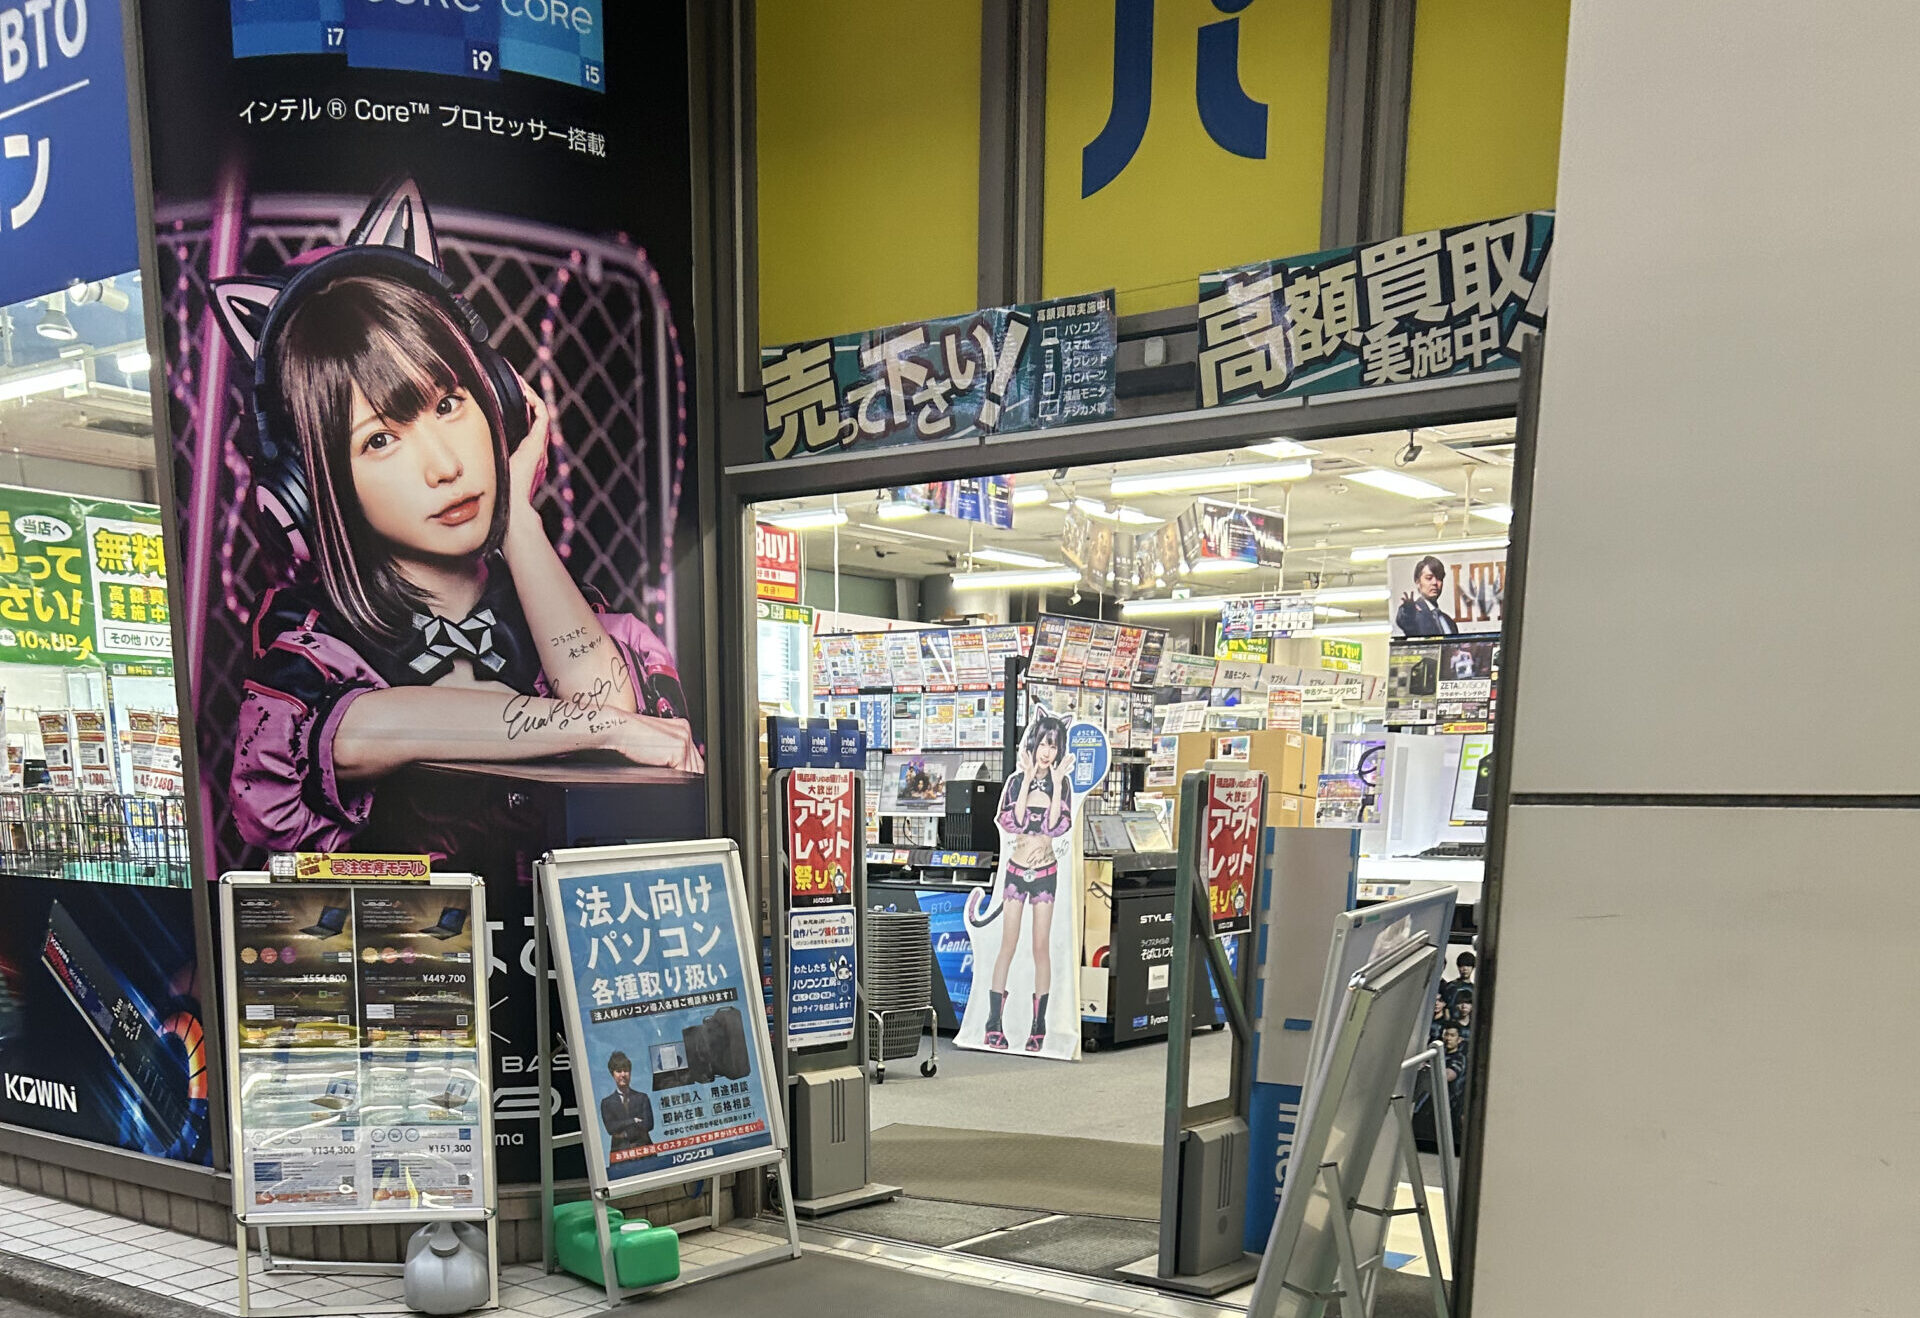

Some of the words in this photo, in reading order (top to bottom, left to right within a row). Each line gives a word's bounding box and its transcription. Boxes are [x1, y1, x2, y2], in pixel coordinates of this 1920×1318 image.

[0, 0, 88, 84] BTO
[326, 27, 345, 46] i7
[471, 49, 493, 72] i9
[584, 64, 601, 84] i5
[239, 98, 321, 124] インテル
[438, 104, 606, 158] プロセッサー搭載
[1064, 320, 1100, 337] パソコン
[1063, 338, 1091, 353] スマホ
[23, 518, 66, 537] 当店へ
[756, 525, 796, 563] Buy!
[110, 632, 142, 647] その他
[794, 799, 850, 828] アウト
[331, 858, 427, 878] 受注生産モデル
[794, 864, 829, 892] 祭り
[575, 875, 713, 929] 法人向け
[1139, 913, 1172, 924] STYLE
[586, 919, 721, 970] パソコン
[422, 973, 467, 984] ¥449,700
[793, 963, 828, 974] わたしたち
[591, 962, 728, 1006] 各種取り扱い
[311, 1145, 356, 1155] ¥134,300
[428, 1144, 472, 1154] ¥151,300
